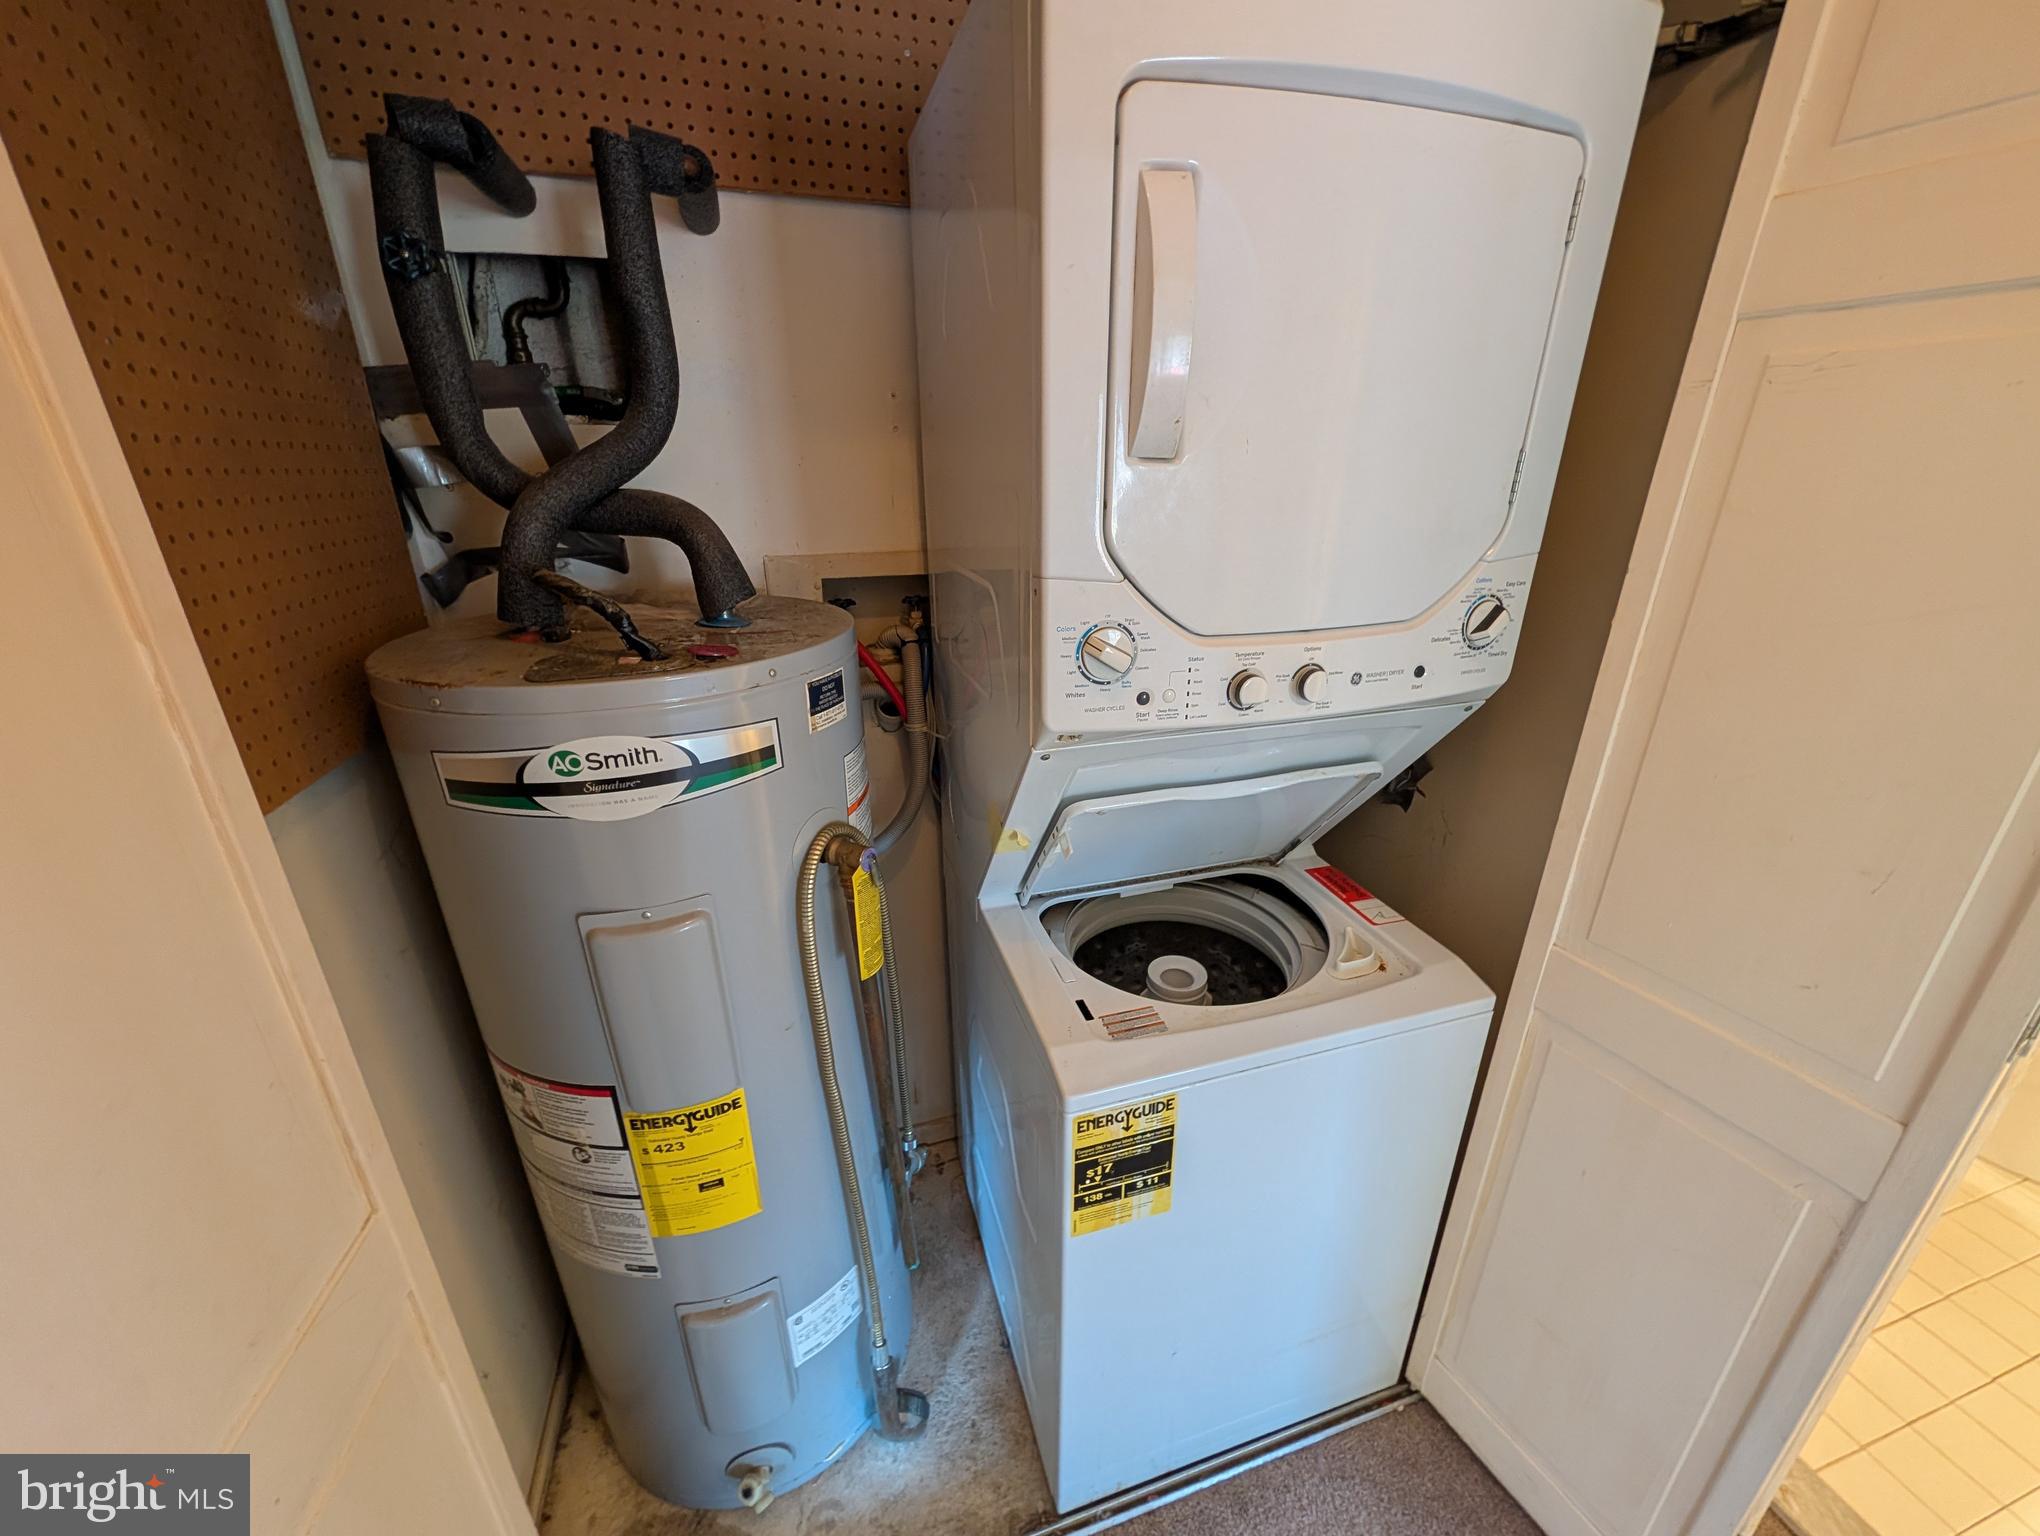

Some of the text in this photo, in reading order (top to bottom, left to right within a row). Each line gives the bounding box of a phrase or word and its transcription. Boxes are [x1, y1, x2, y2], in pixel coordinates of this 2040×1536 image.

[1135, 711, 1150, 719] Start
[629, 1097, 742, 1132] ENERGYGUIDE
[1077, 1097, 1176, 1133] ENERGYGUIDE
[653, 1141, 686, 1154] 423
[1086, 1163, 1114, 1178] $17
[1083, 1192, 1104, 1203] 138
